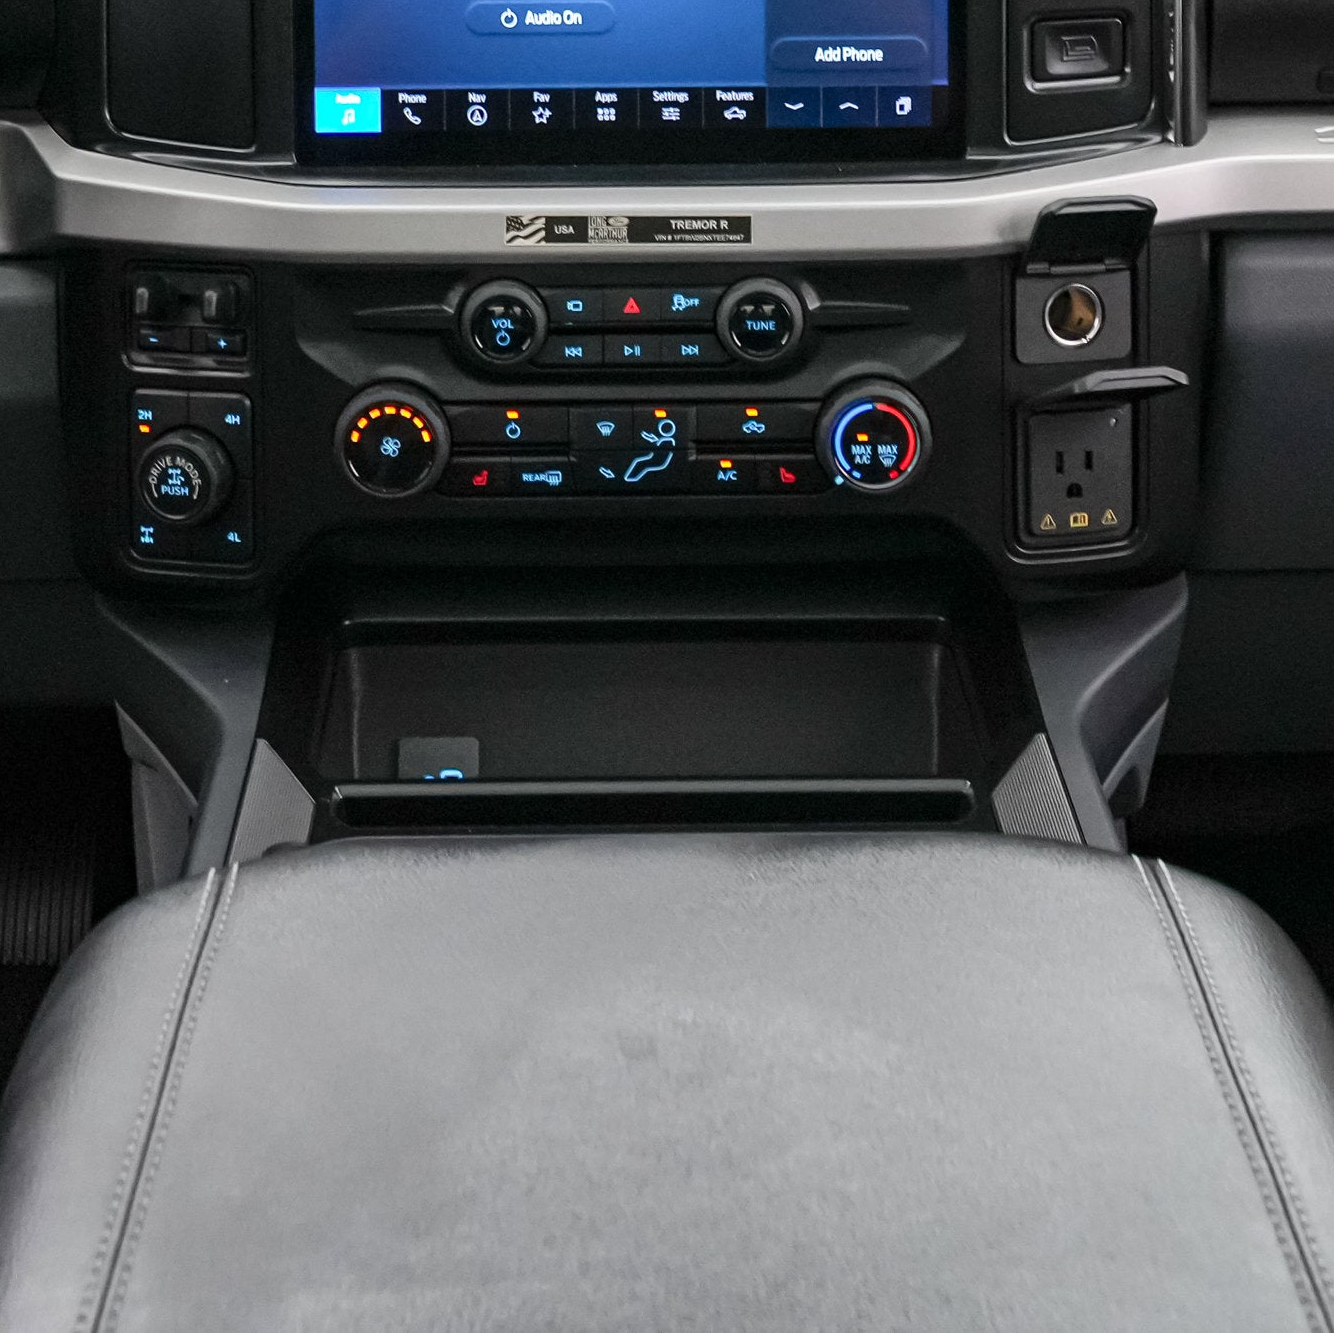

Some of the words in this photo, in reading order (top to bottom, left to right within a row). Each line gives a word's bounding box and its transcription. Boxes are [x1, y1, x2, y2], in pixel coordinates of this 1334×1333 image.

[525, 10, 560, 26] Audio
[562, 11, 582, 26] On
[815, 46, 839, 62] Add
[841, 46, 884, 62] Phone
[398, 92, 427, 104] Phone
[468, 92, 487, 103] Nav
[533, 91, 551, 103] Fav
[595, 90, 618, 104] Apps
[652, 90, 690, 103] Settings
[715, 89, 755, 102] Features
[554, 225, 575, 235] USA
[669, 219, 717, 230] TREMOR
[720, 219, 729, 230] R
[654, 234, 668, 242] VIN
[684, 297, 700, 307] OFF
[491, 319, 514, 330] VOL
[746, 320, 776, 331] TUNE
[137, 409, 152, 420] 2H
[224, 414, 241, 425] 4H
[851, 444, 872, 454] MAX
[877, 444, 898, 454] MAX
[854, 454, 871, 464] A/C
[148, 456, 174, 485] DRIVE
[176, 456, 202, 486] MODE
[717, 470, 738, 482] A/C
[522, 473, 546, 482] REAR
[161, 485, 189, 496] PUSH
[226, 531, 242, 543] 4L
